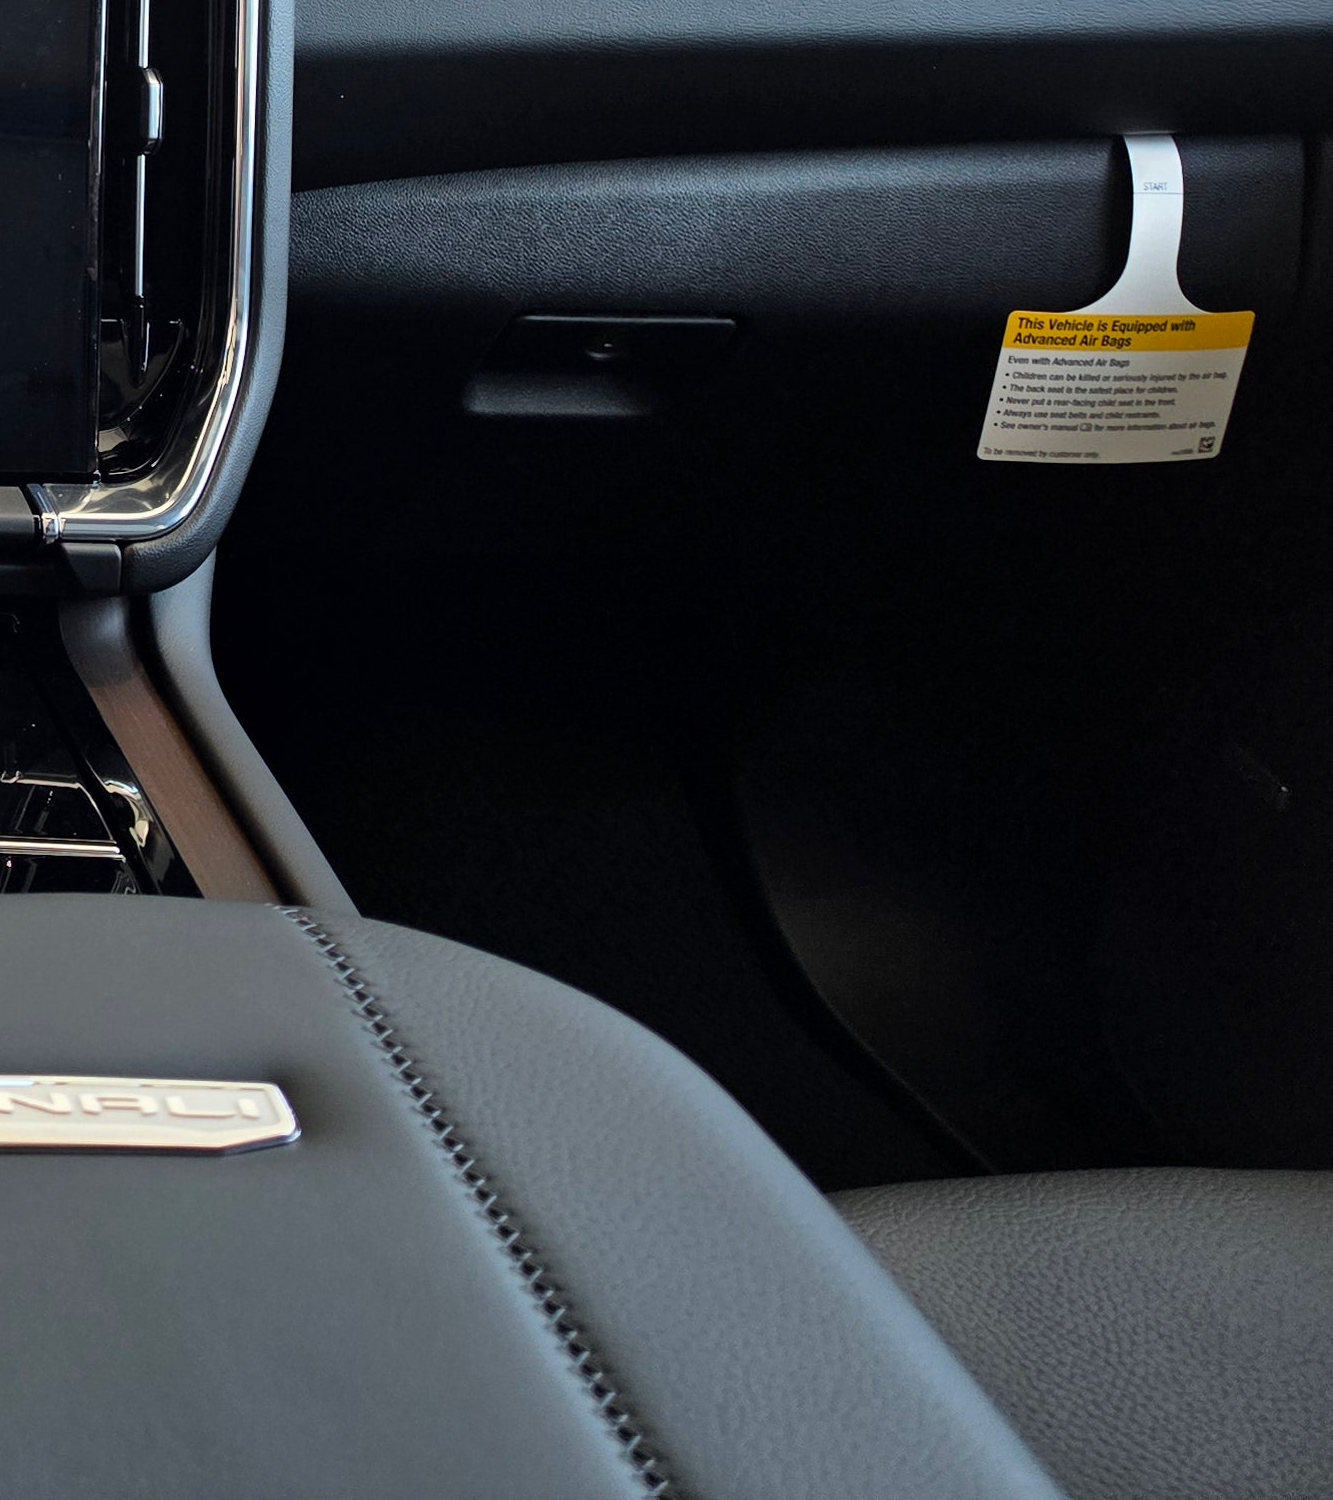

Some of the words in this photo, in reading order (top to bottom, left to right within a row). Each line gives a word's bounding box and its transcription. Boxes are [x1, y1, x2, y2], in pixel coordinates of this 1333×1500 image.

[1143, 182, 1168, 191] START
[1018, 317, 1044, 329] This
[1049, 318, 1093, 332] Vehicle
[1096, 320, 1107, 332] is
[1111, 320, 1168, 334] Equipped
[1170, 319, 1196, 332] with
[1013, 332, 1077, 346] Advanced
[1079, 334, 1097, 346] Air
[1100, 335, 1132, 349] Bags
[1008, 355, 1029, 364] Even
[1032, 357, 1050, 365] with
[1052, 357, 1094, 367] Advanced
[1095, 359, 1108, 367] Air
[1109, 358, 1131, 368] Bags
[1012, 372, 1047, 380] Children
[1066, 373, 1076, 381] be
[1078, 373, 1101, 381] killed
[1010, 384, 1024, 392] The
[1026, 385, 1045, 393] back
[1006, 396, 1030, 405] Never
[1003, 409, 1031, 418] Always
[1000, 421, 1016, 429] See
